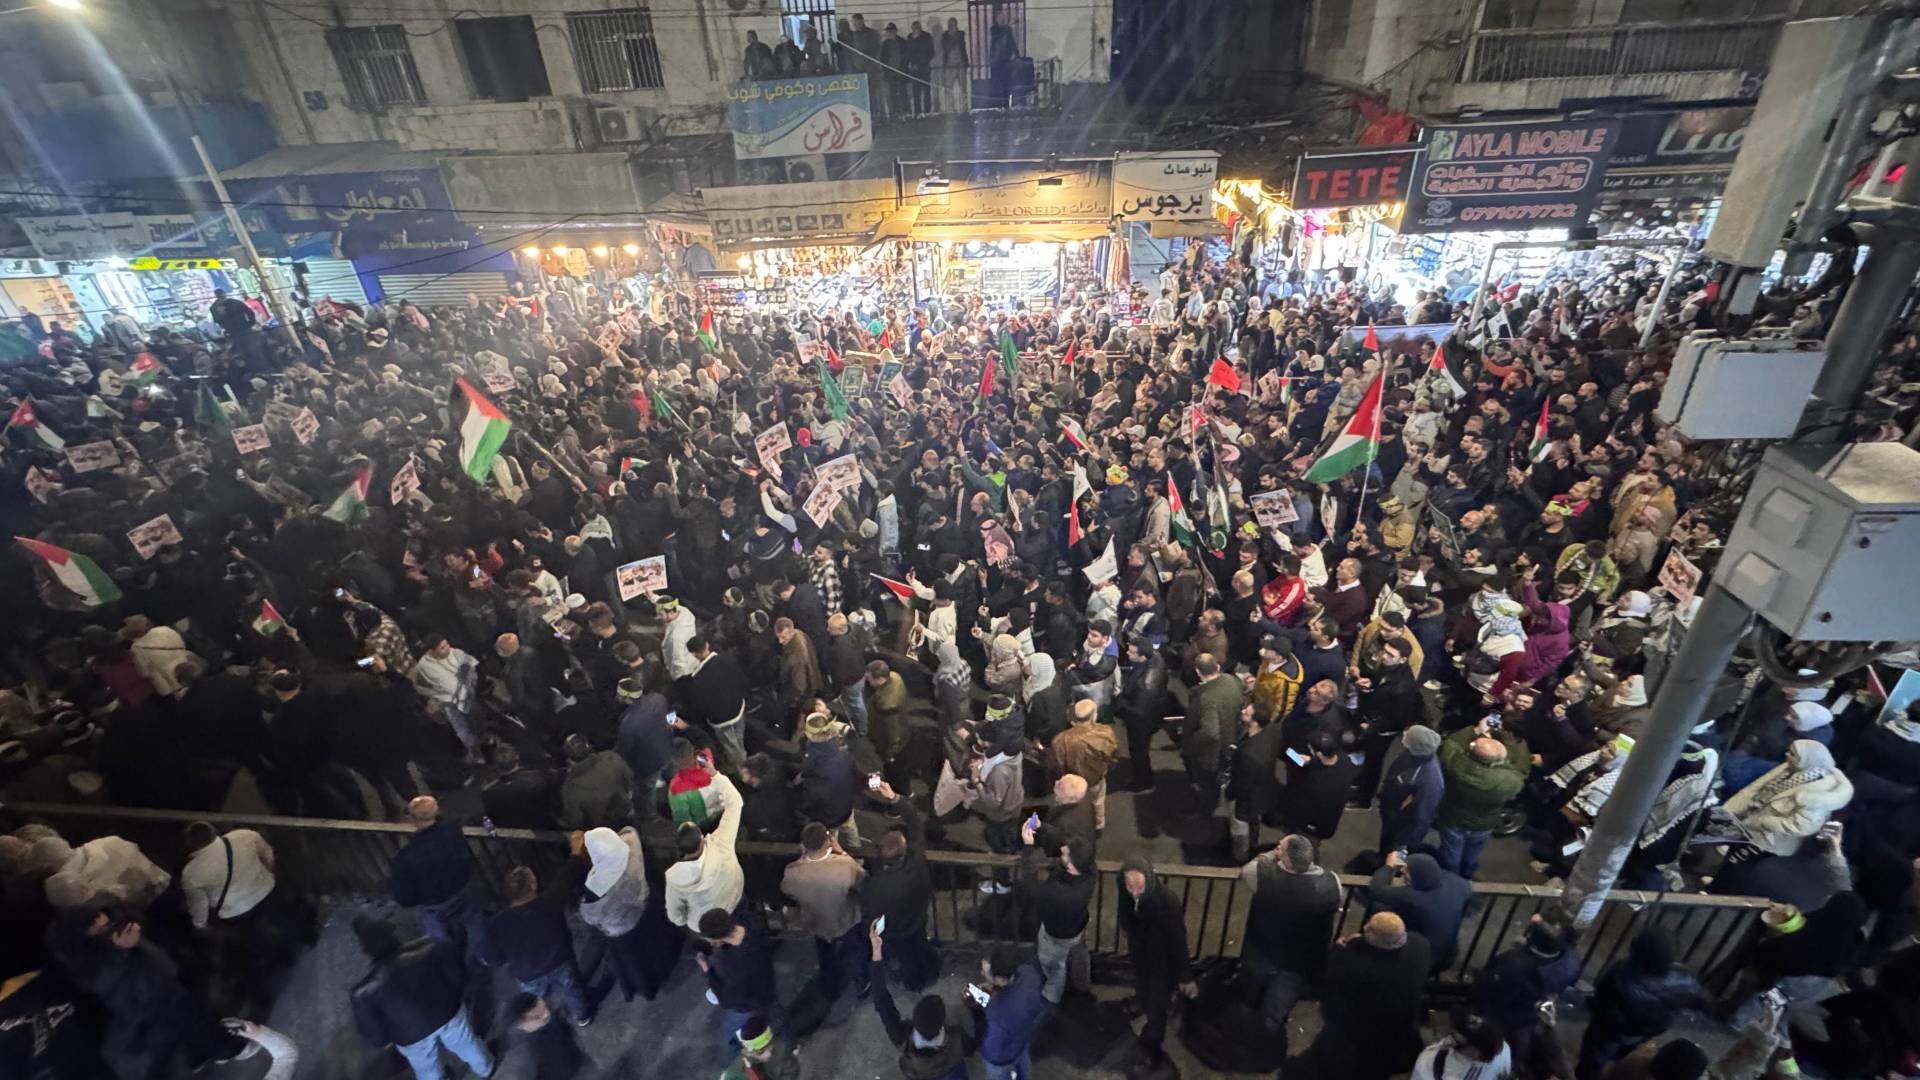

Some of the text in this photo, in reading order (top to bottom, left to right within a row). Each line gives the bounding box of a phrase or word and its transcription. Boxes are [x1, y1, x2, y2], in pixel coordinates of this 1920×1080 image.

[728, 78, 861, 104] مقهى وكوفي شوب
[804, 109, 866, 151] فراس
[1455, 128, 1608, 158] AYLA MOBILE
[1163, 162, 1213, 177] ملبوسات
[1536, 161, 1587, 178] عالم
[1306, 166, 1402, 200] TETE
[1122, 193, 1203, 217] برجوس
